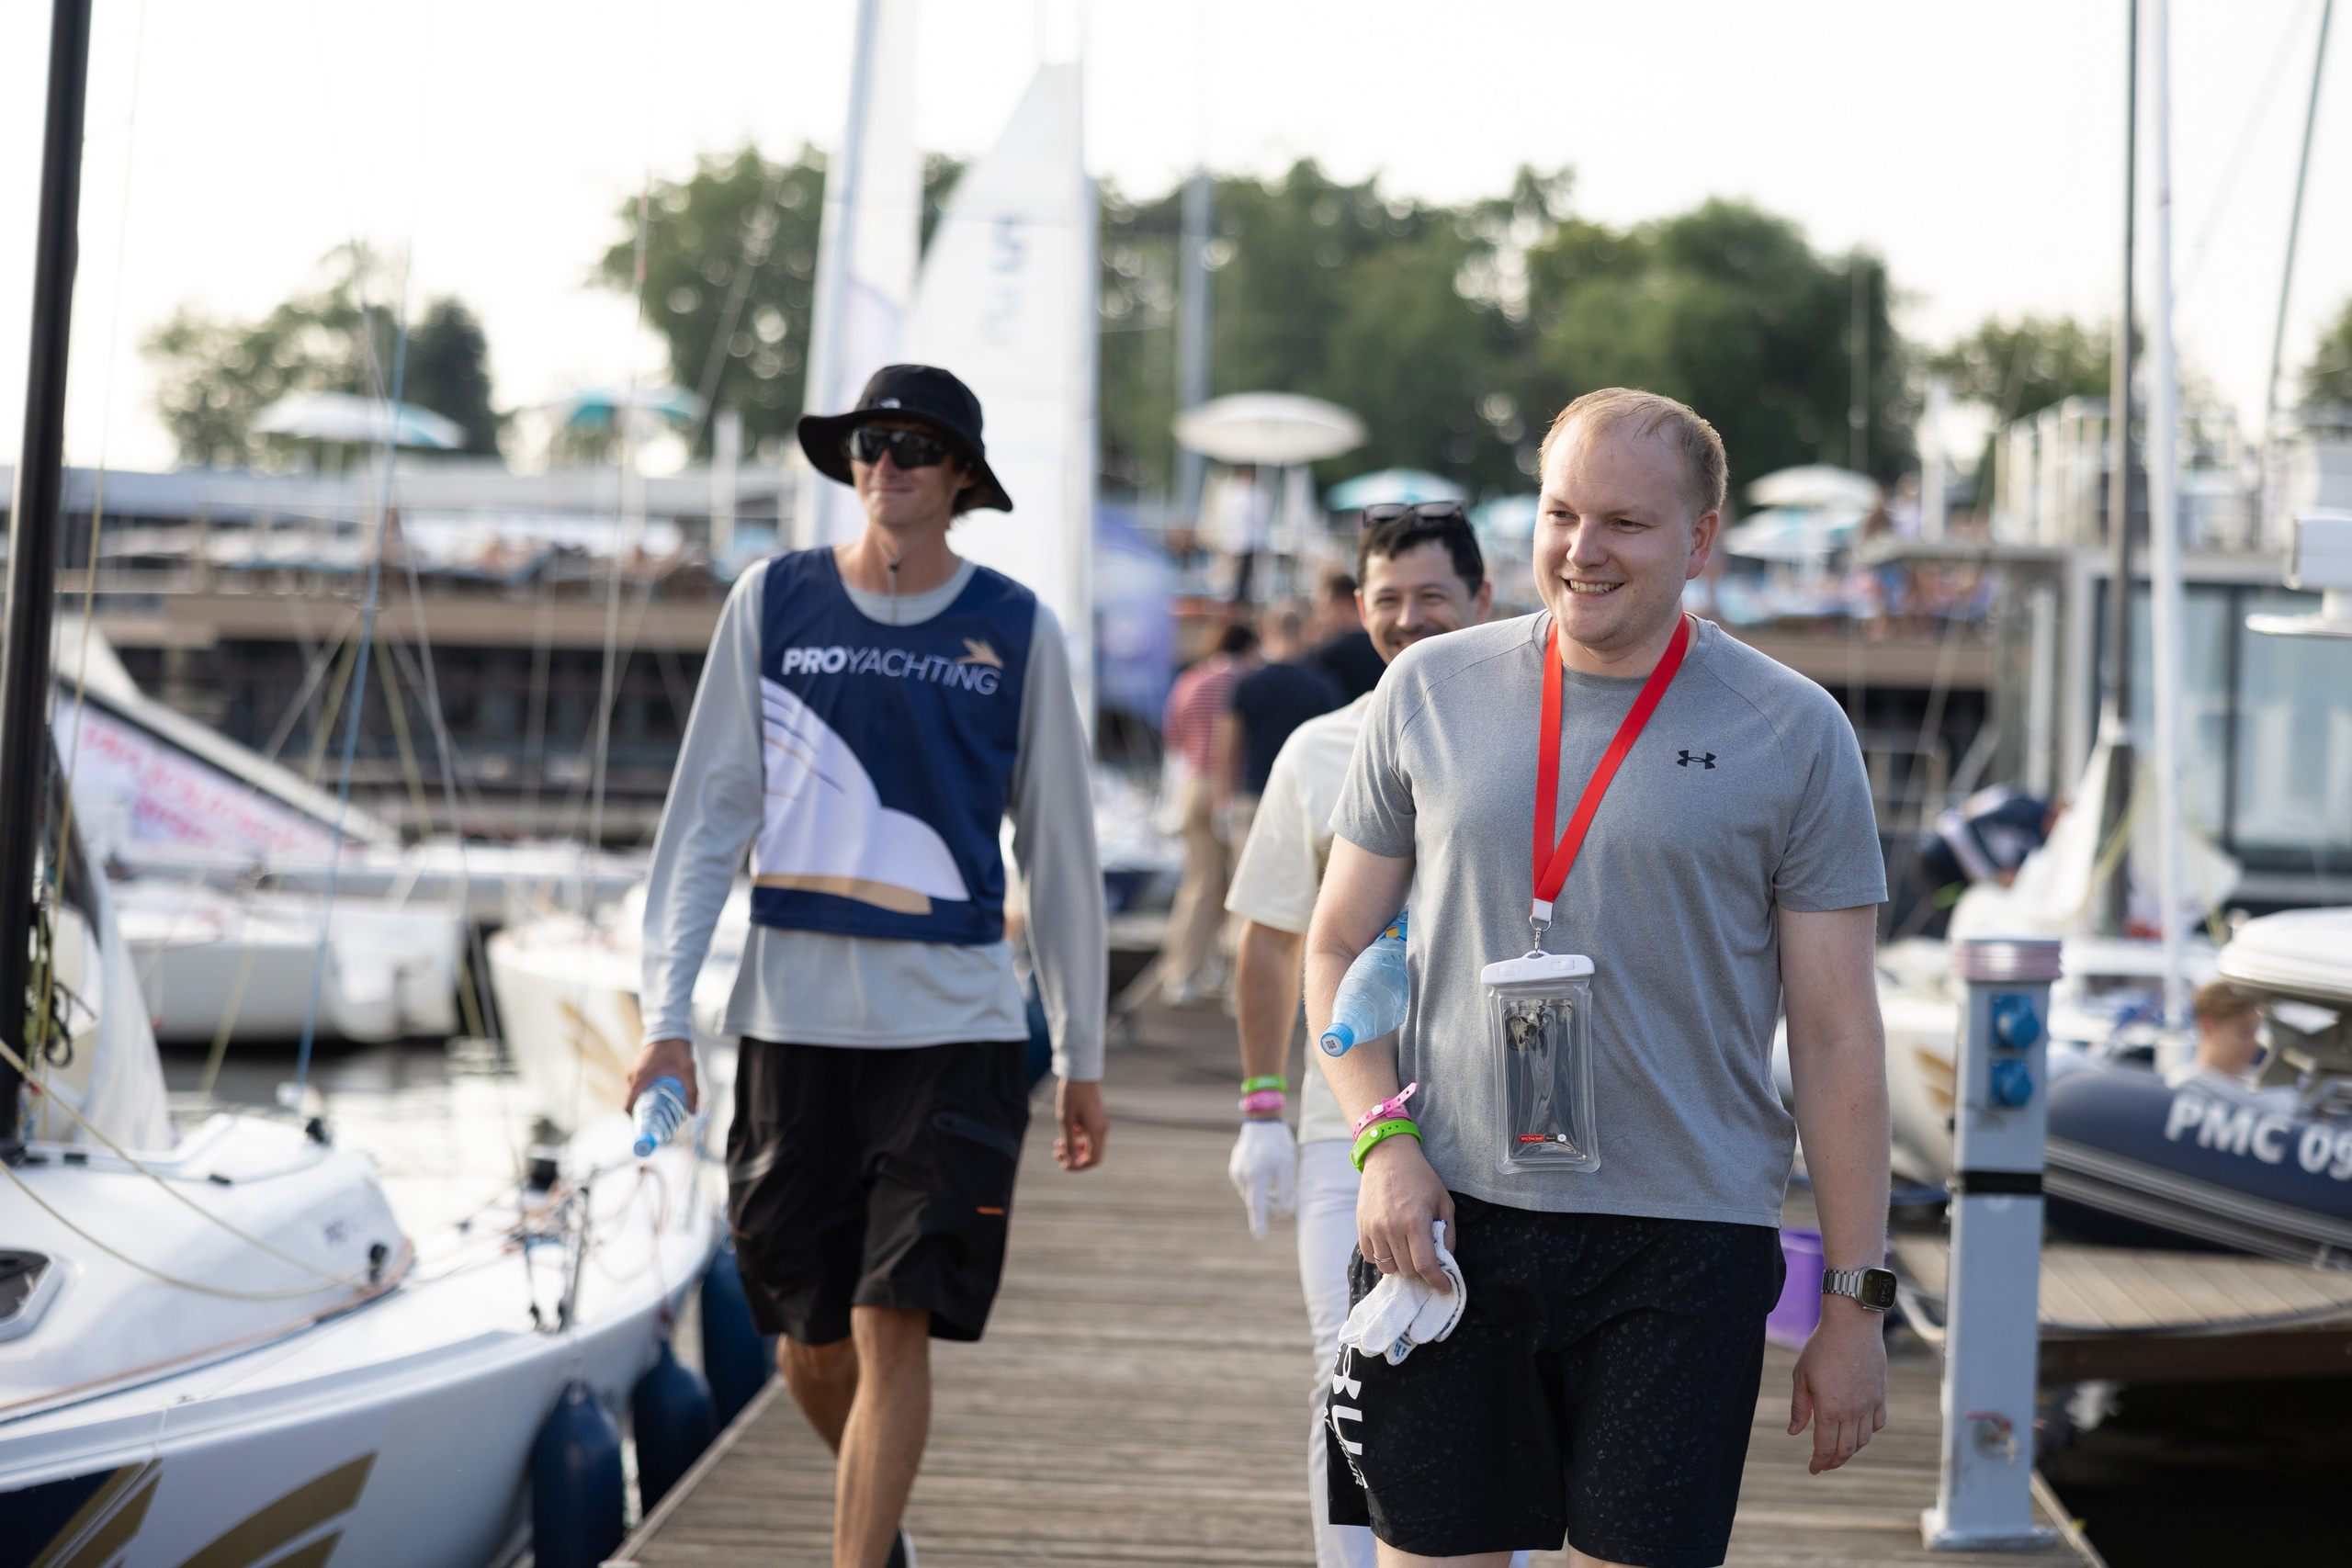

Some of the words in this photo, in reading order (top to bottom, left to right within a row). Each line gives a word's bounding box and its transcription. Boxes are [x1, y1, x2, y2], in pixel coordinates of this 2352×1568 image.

[782, 645, 1001, 695] PROYACHTING
[2165, 1092, 2291, 1165] PMC
[2299, 1123, 2352, 1181] 09
